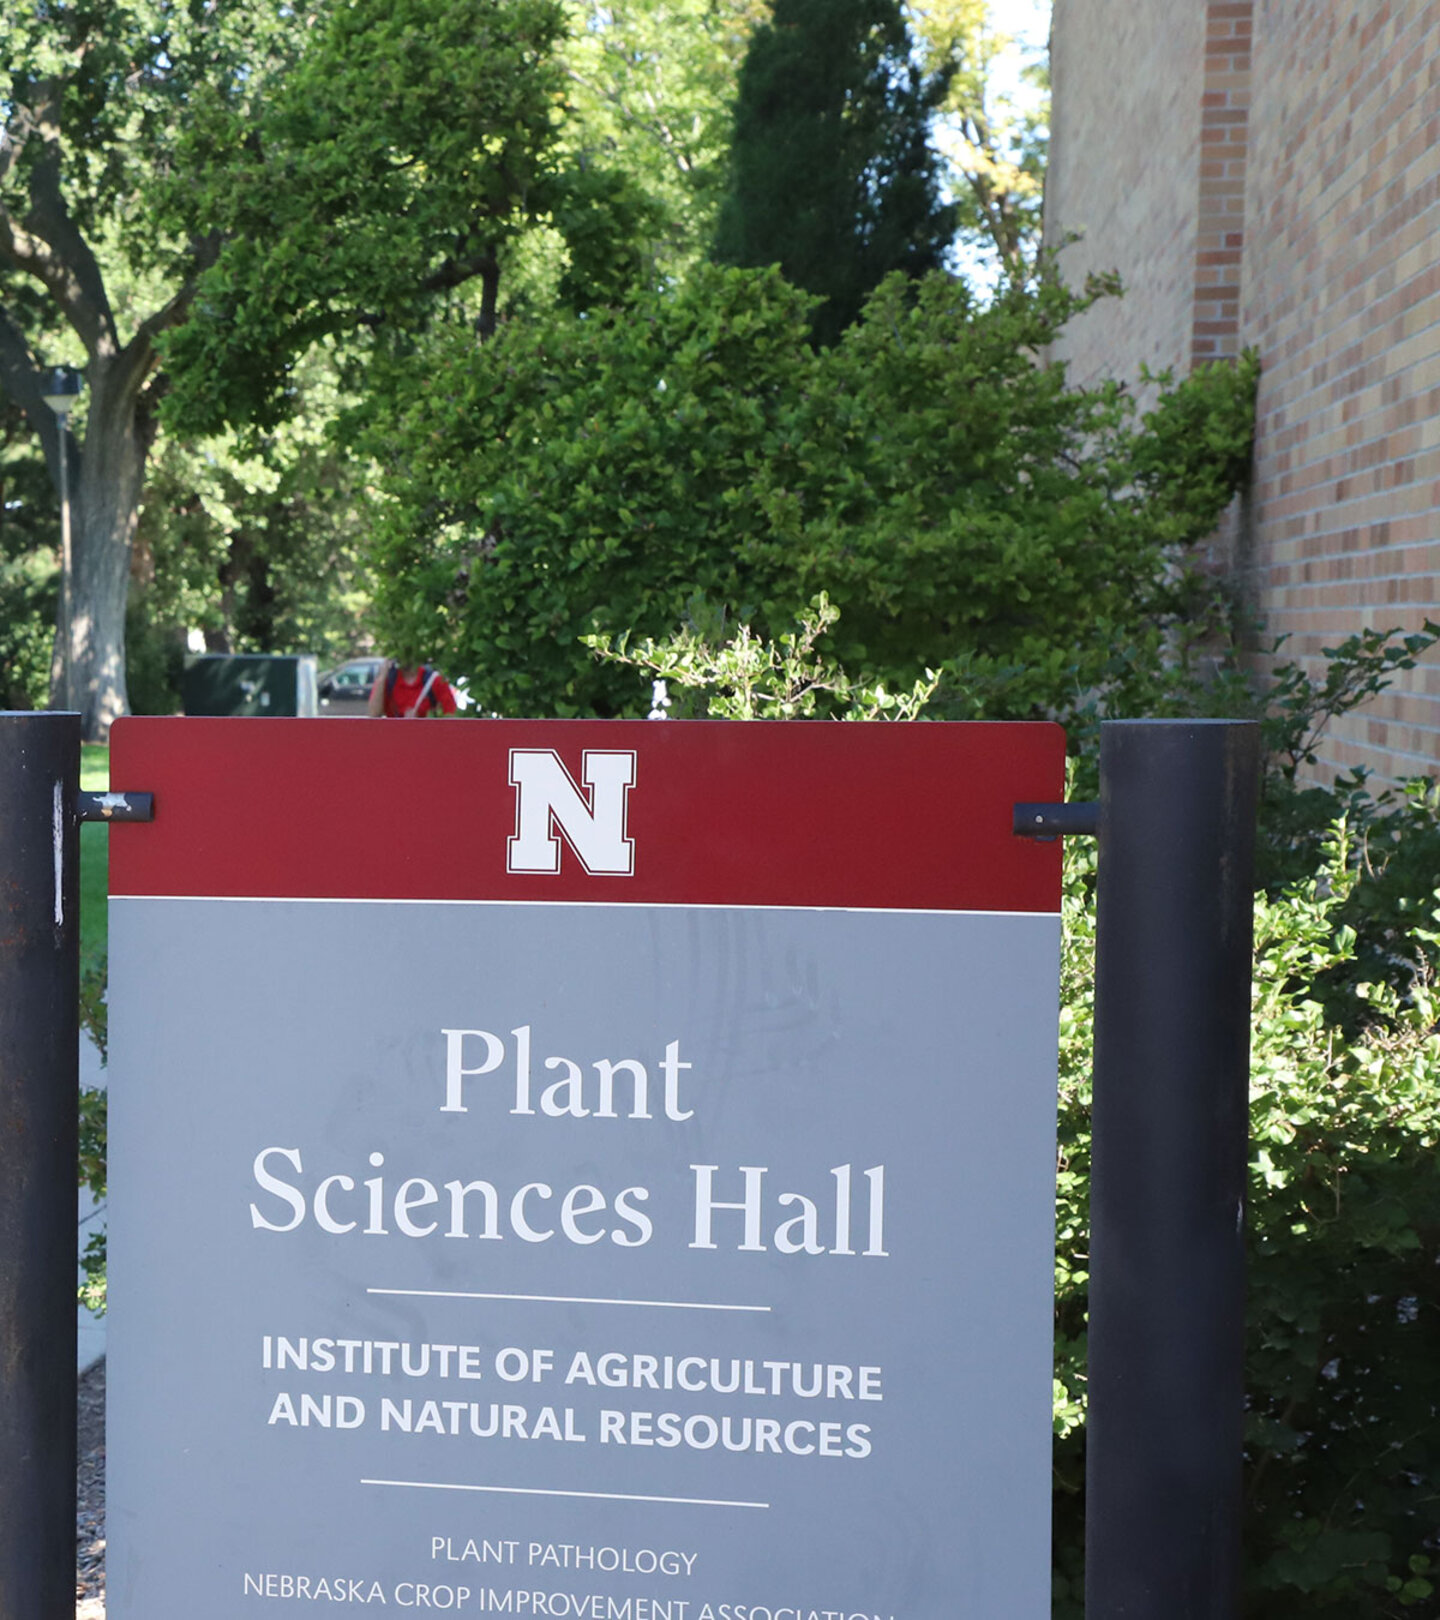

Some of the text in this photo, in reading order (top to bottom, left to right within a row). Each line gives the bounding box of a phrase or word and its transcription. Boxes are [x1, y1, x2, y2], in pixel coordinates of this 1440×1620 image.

[506, 748, 637, 877] N
[439, 1025, 694, 1122] Plant
[249, 1146, 889, 1257] Sciences Hall
[262, 1335, 883, 1401] INSTITUTE OF AGRICULTURE
[267, 1392, 872, 1459] AND NATURAL RESOURCES
[431, 1536, 698, 1576] PLANT PATHOLOGY
[244, 1572, 386, 1604] NEBRASKA
[394, 1583, 471, 1609] CROP
[480, 1588, 690, 1620] IMPROVEMENT
